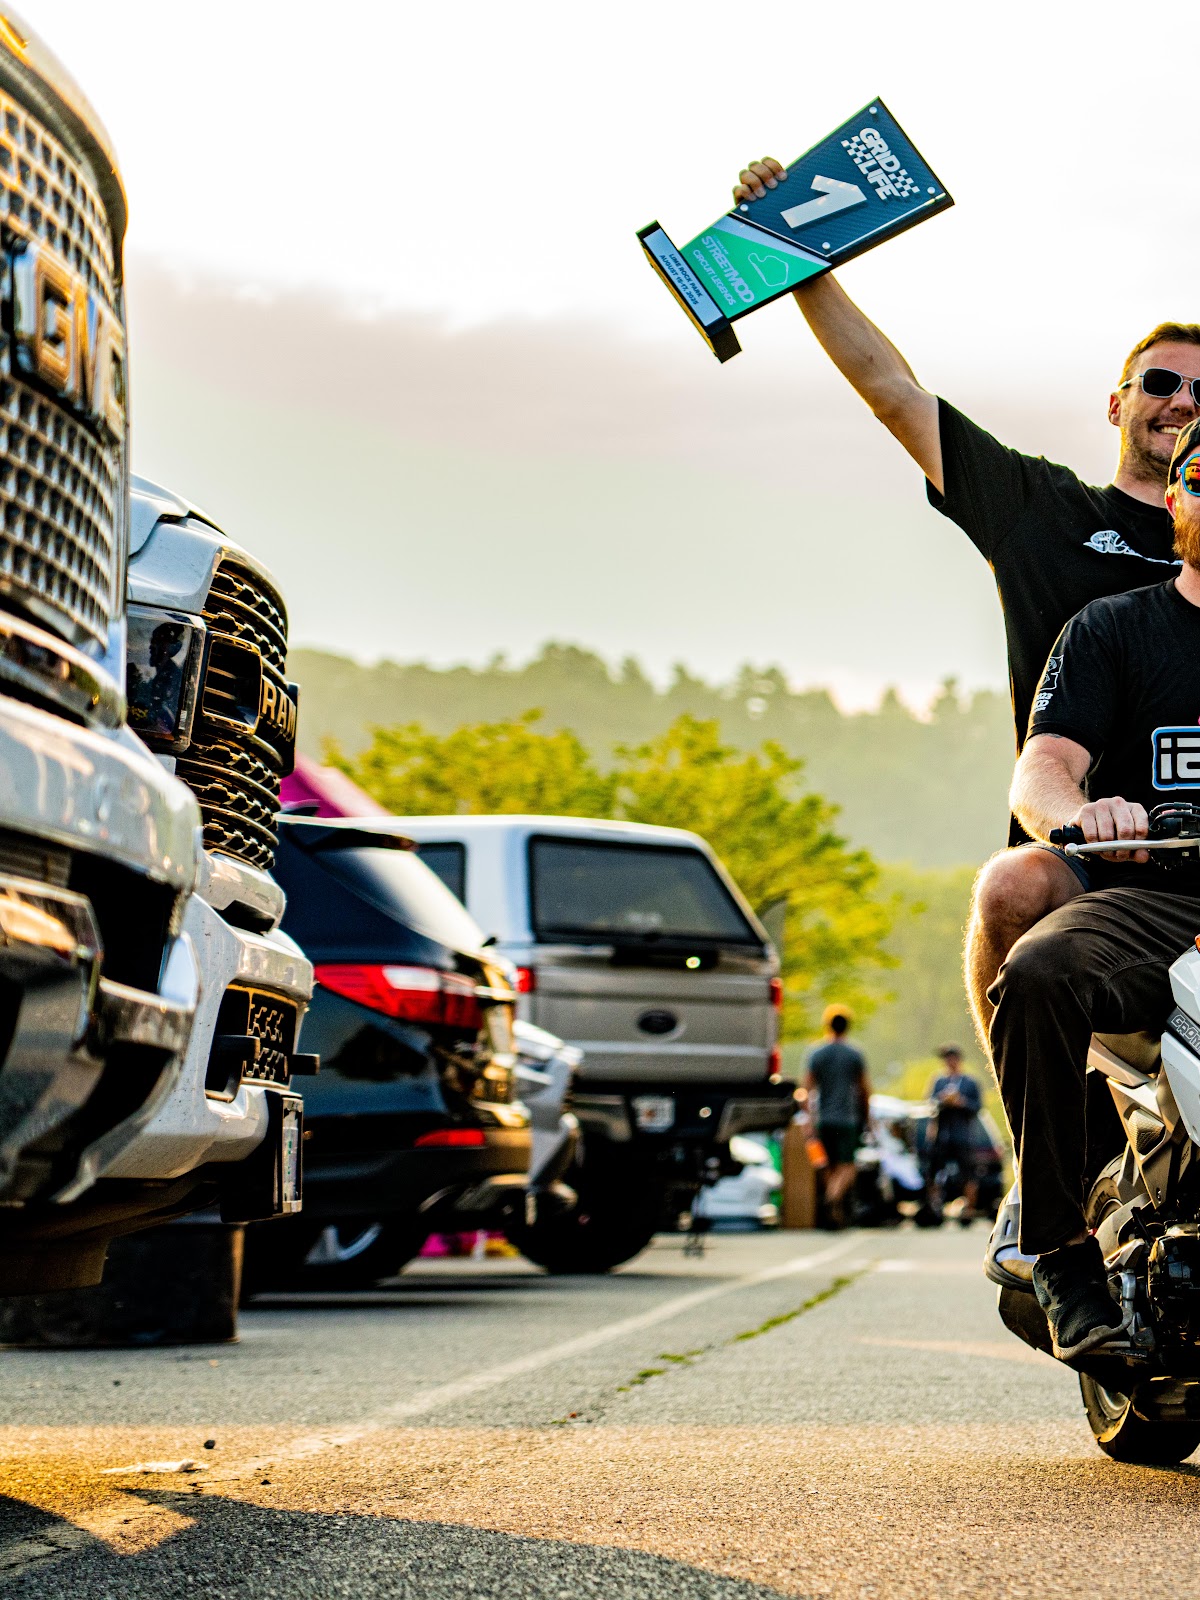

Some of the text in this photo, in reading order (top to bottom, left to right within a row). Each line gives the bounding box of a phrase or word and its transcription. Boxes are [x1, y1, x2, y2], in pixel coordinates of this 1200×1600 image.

[860, 127, 901, 172] GRID
[780, 175, 867, 229] 1
[857, 159, 901, 200] LIFE
[660, 254, 678, 276] AUGUST
[668, 253, 703, 297] LIME ROCK PARK
[692, 249, 715, 276] CIRCUIT
[712, 274, 736, 305] LEGENDS
[261, 679, 296, 738] RAM
